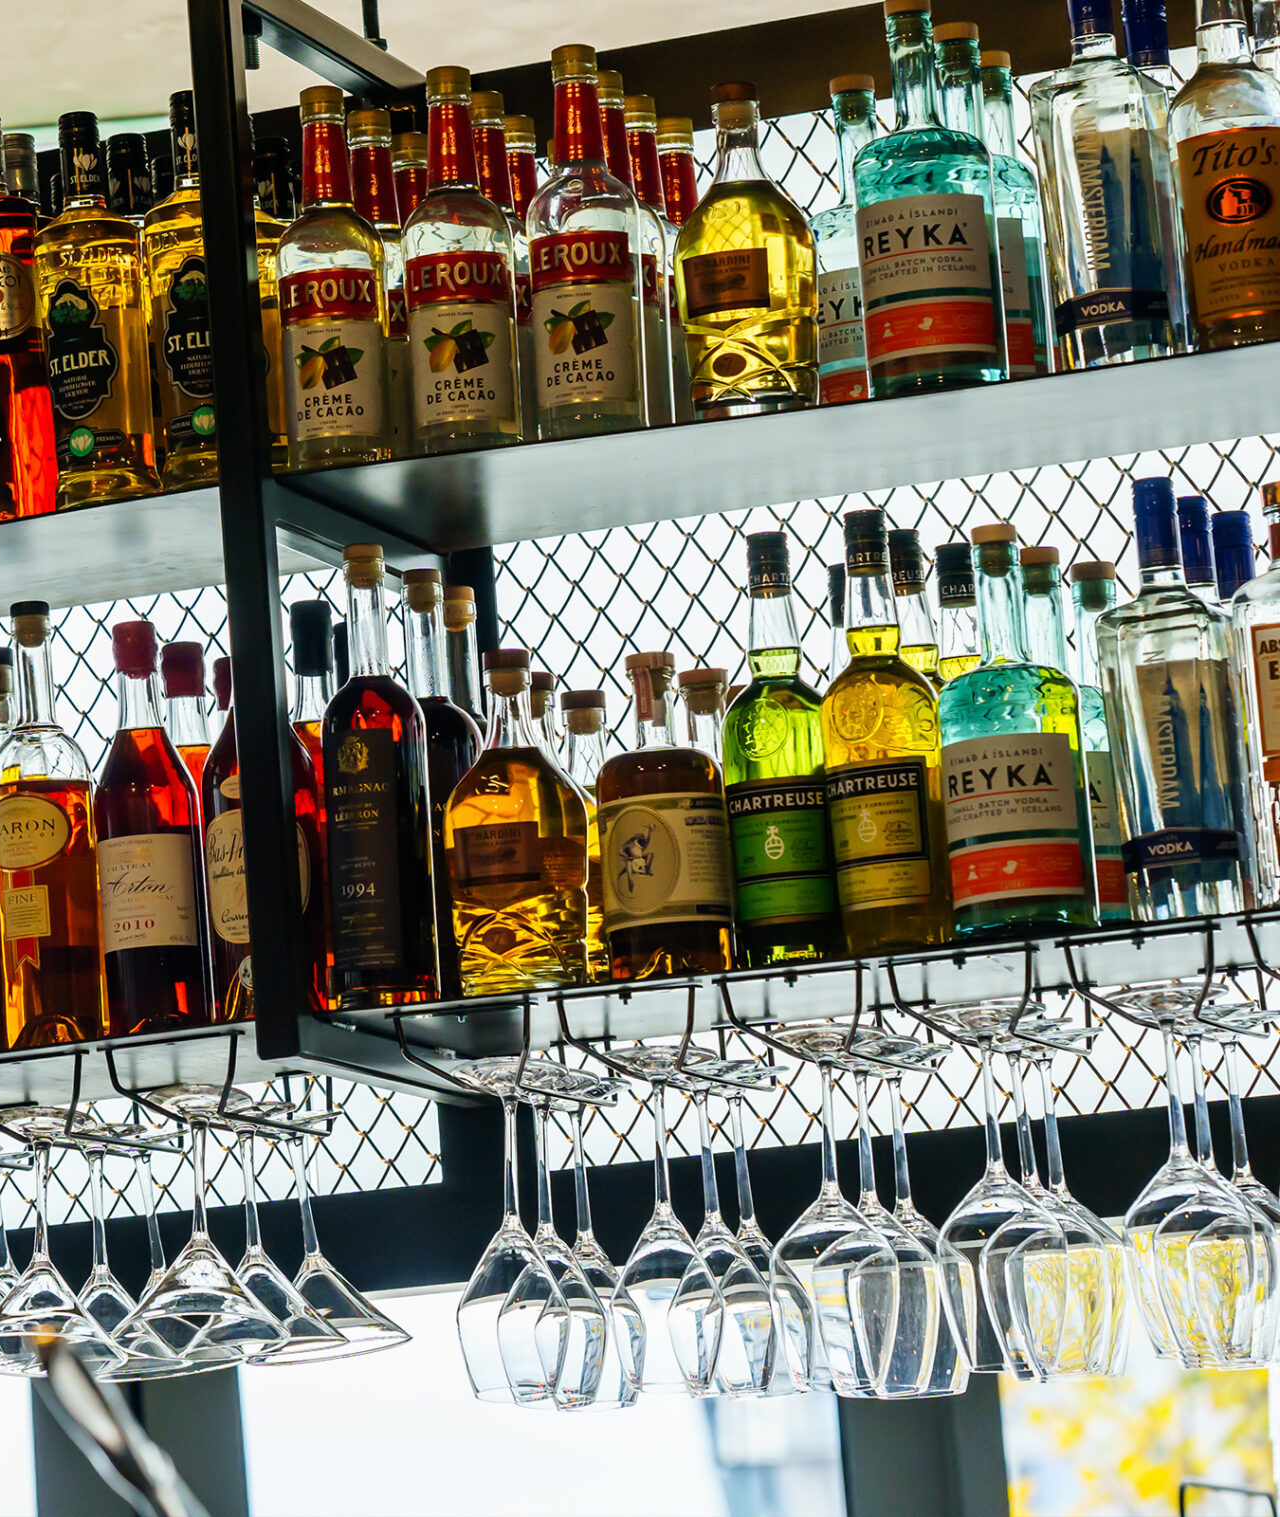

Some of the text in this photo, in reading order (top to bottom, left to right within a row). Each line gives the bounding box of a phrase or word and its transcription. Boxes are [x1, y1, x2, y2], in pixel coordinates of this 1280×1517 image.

[1192, 137, 1277, 177] Tito's
[1078, 158, 1111, 271] AMSTERDAM
[864, 224, 968, 259] REYKA
[533, 242, 623, 273] LEROUX
[894, 258, 925, 269] BATCH
[931, 255, 963, 264] VODKA
[1219, 258, 1275, 272] VODKA
[410, 261, 503, 292] LEROUX
[879, 268, 918, 282] CRAFTED
[922, 265, 933, 273] IN
[937, 263, 977, 272] ICELAND
[1080, 301, 1125, 317] VODKA
[827, 327, 856, 338] BATCH
[168, 335, 184, 353] ST.
[49, 350, 111, 377] ST. ELDER
[554, 358, 603, 373] CRÈME
[434, 377, 485, 391] CRÈME
[547, 371, 615, 387] DE CACAO
[304, 393, 353, 408] CRÈME
[426, 390, 496, 405] DE CACAO
[297, 406, 365, 422] DE CACAO
[827, 773, 918, 797] CHARTREUSE
[948, 764, 1053, 797] REYKA
[330, 782, 389, 797] RMAGNAC
[729, 791, 824, 815] CHARTREUSE
[979, 800, 1009, 809] BATCH
[1014, 797, 1048, 805] VODKA
[963, 809, 1001, 821] CRAFTED
[1022, 805, 1063, 814] ICELAND
[1147, 840, 1195, 857] VODKA
[342, 882, 376, 899] 1994
[8, 894, 38, 906] FINE
[113, 919, 155, 933] 2010
